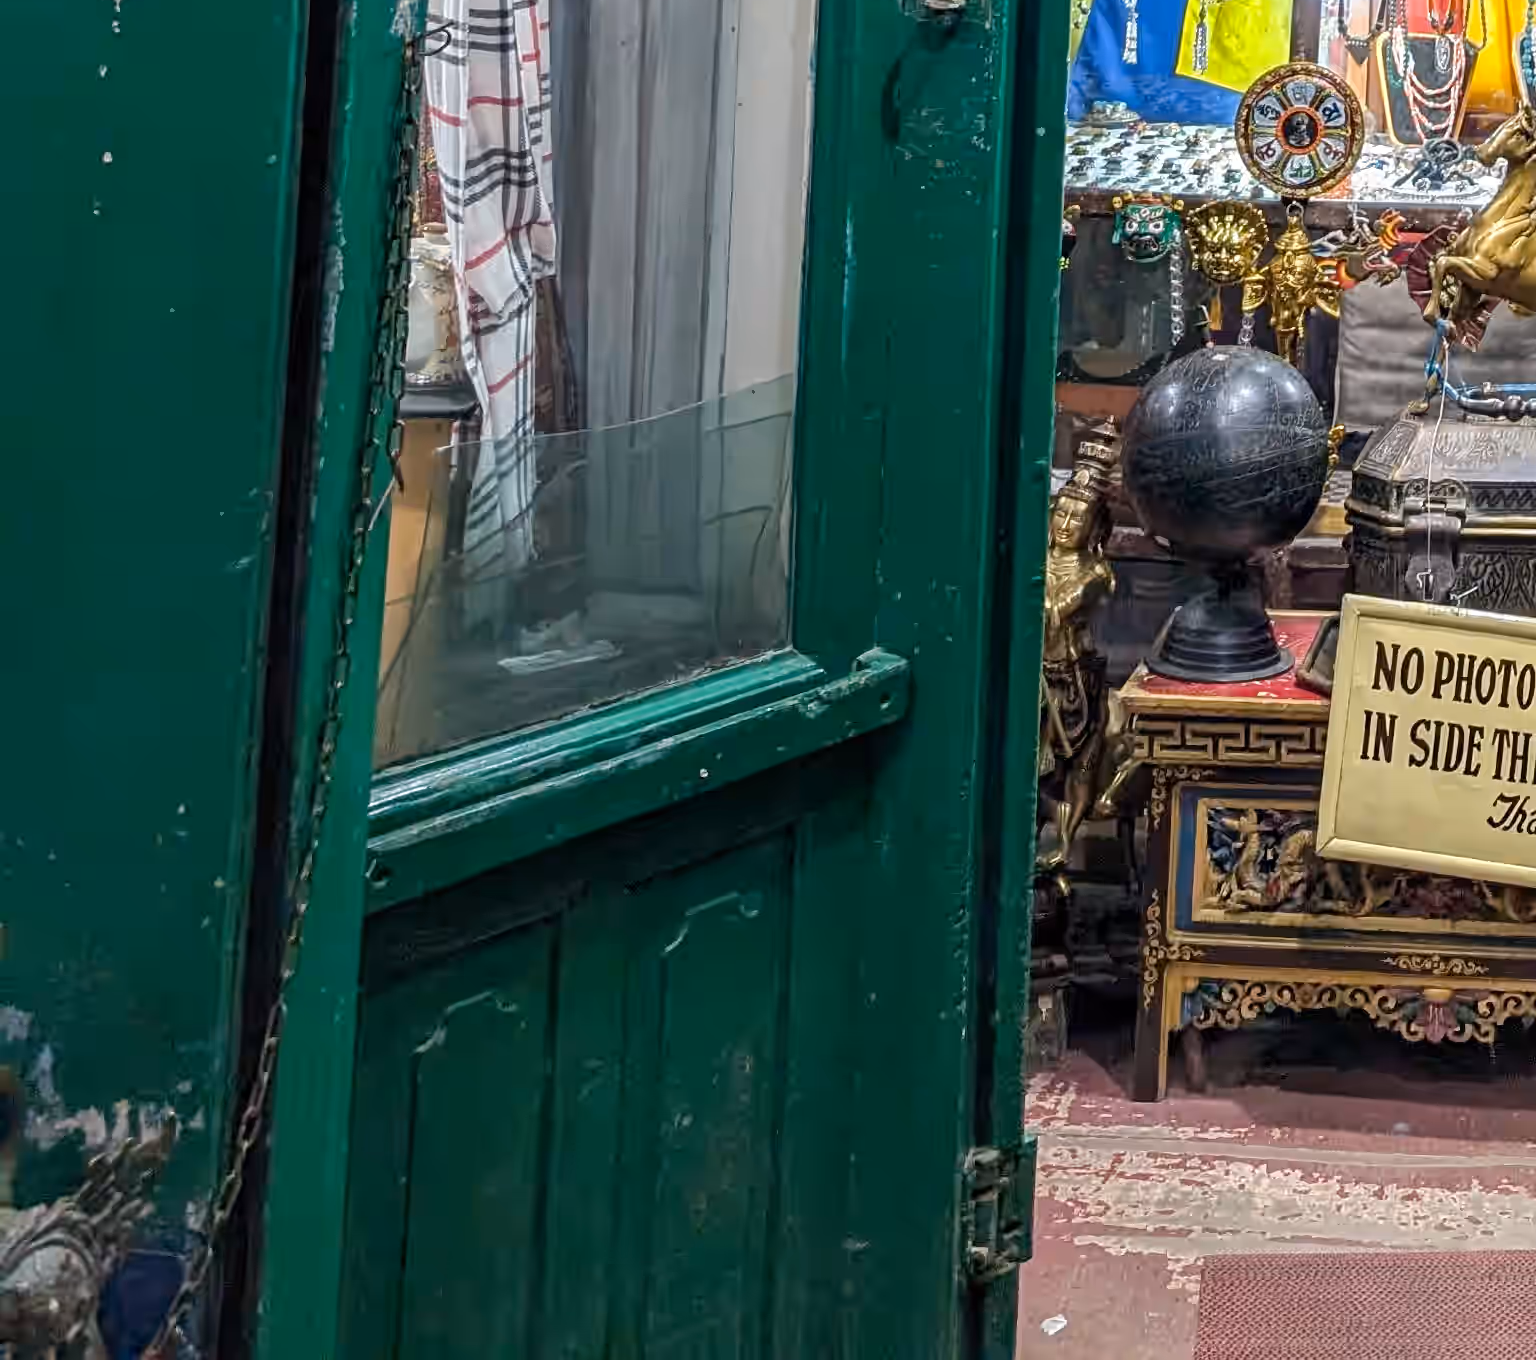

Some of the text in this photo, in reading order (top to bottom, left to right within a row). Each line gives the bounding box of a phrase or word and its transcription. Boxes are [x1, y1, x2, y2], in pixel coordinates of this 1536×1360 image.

[1371, 640, 1425, 696] NO
[1360, 709, 1399, 764] IN
[1408, 718, 1485, 778] SIDE
